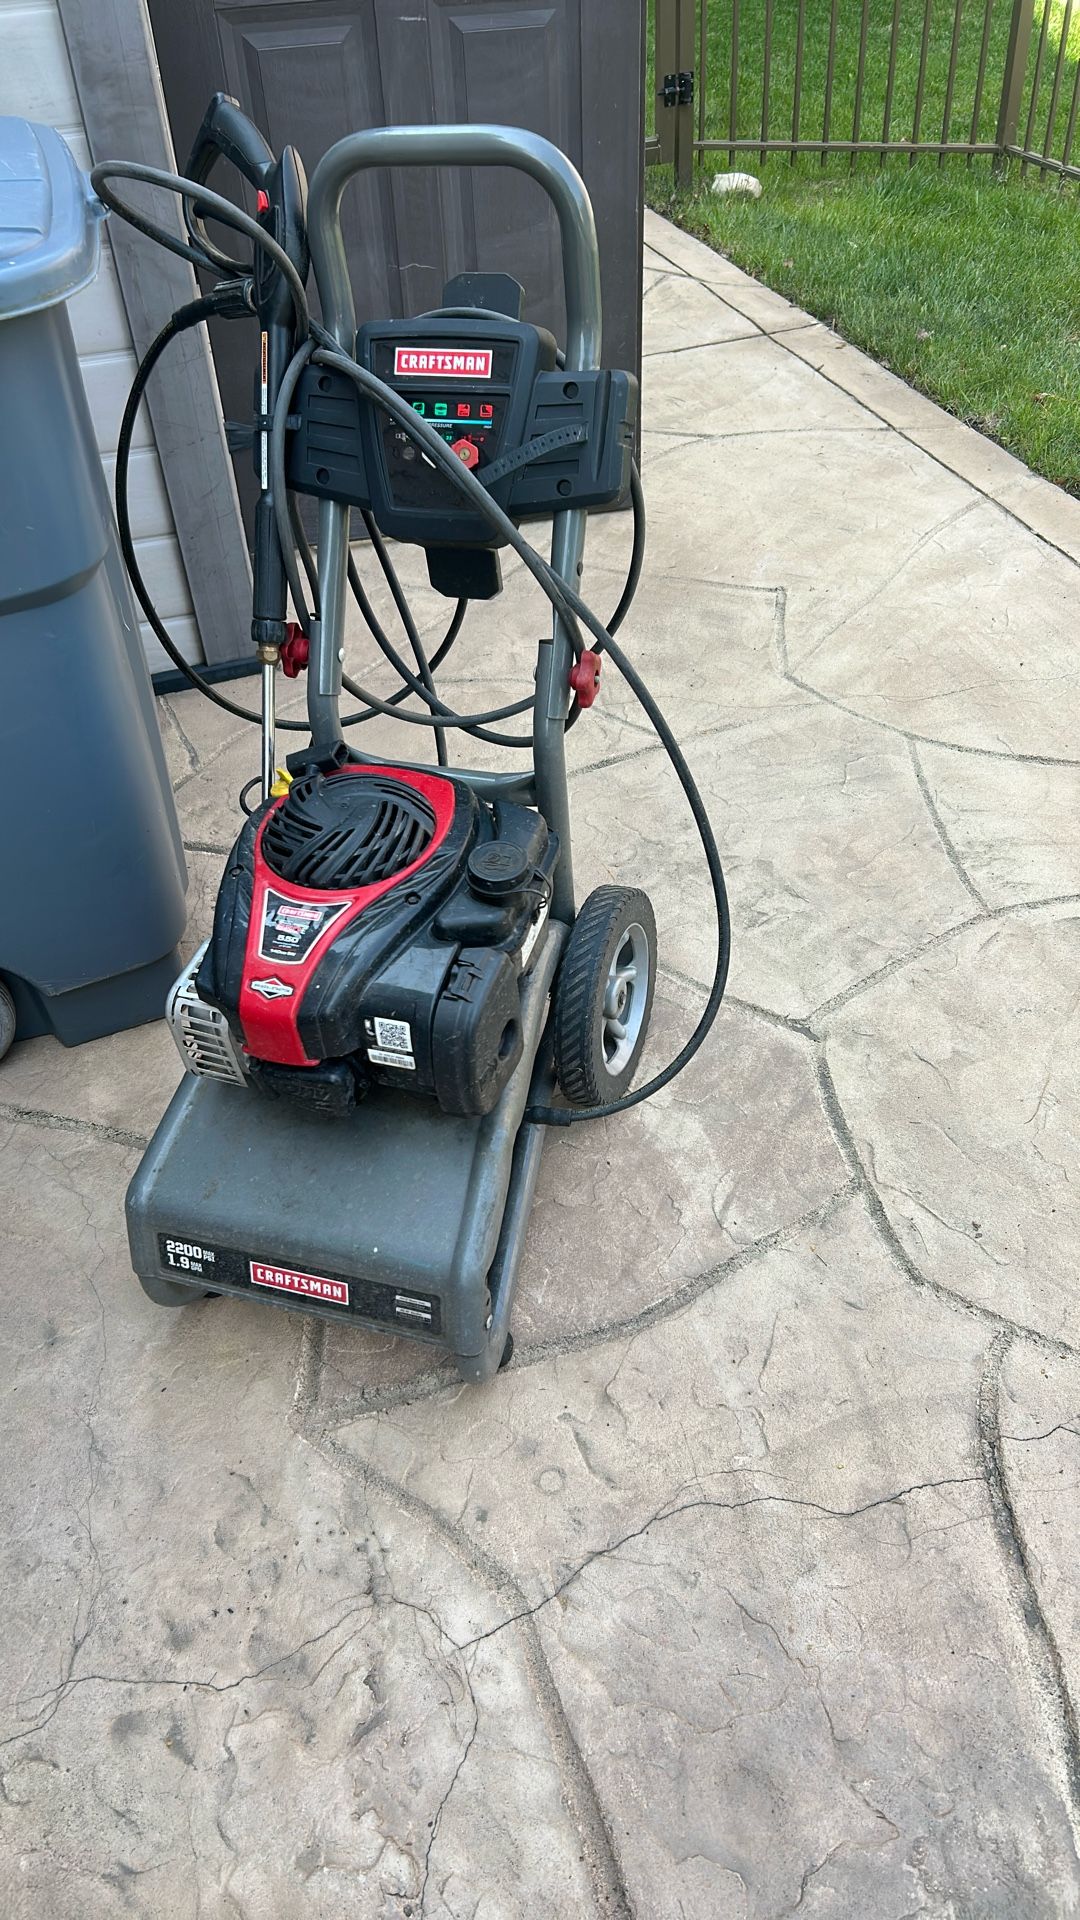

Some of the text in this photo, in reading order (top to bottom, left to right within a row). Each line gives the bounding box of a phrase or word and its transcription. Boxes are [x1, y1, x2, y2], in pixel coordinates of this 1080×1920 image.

[400, 354, 486, 371] CRAFTSMAN
[166, 1239, 202, 1259] 2200
[167, 1252, 190, 1269] 1.9
[256, 1268, 342, 1298] CRAFTSMAN
